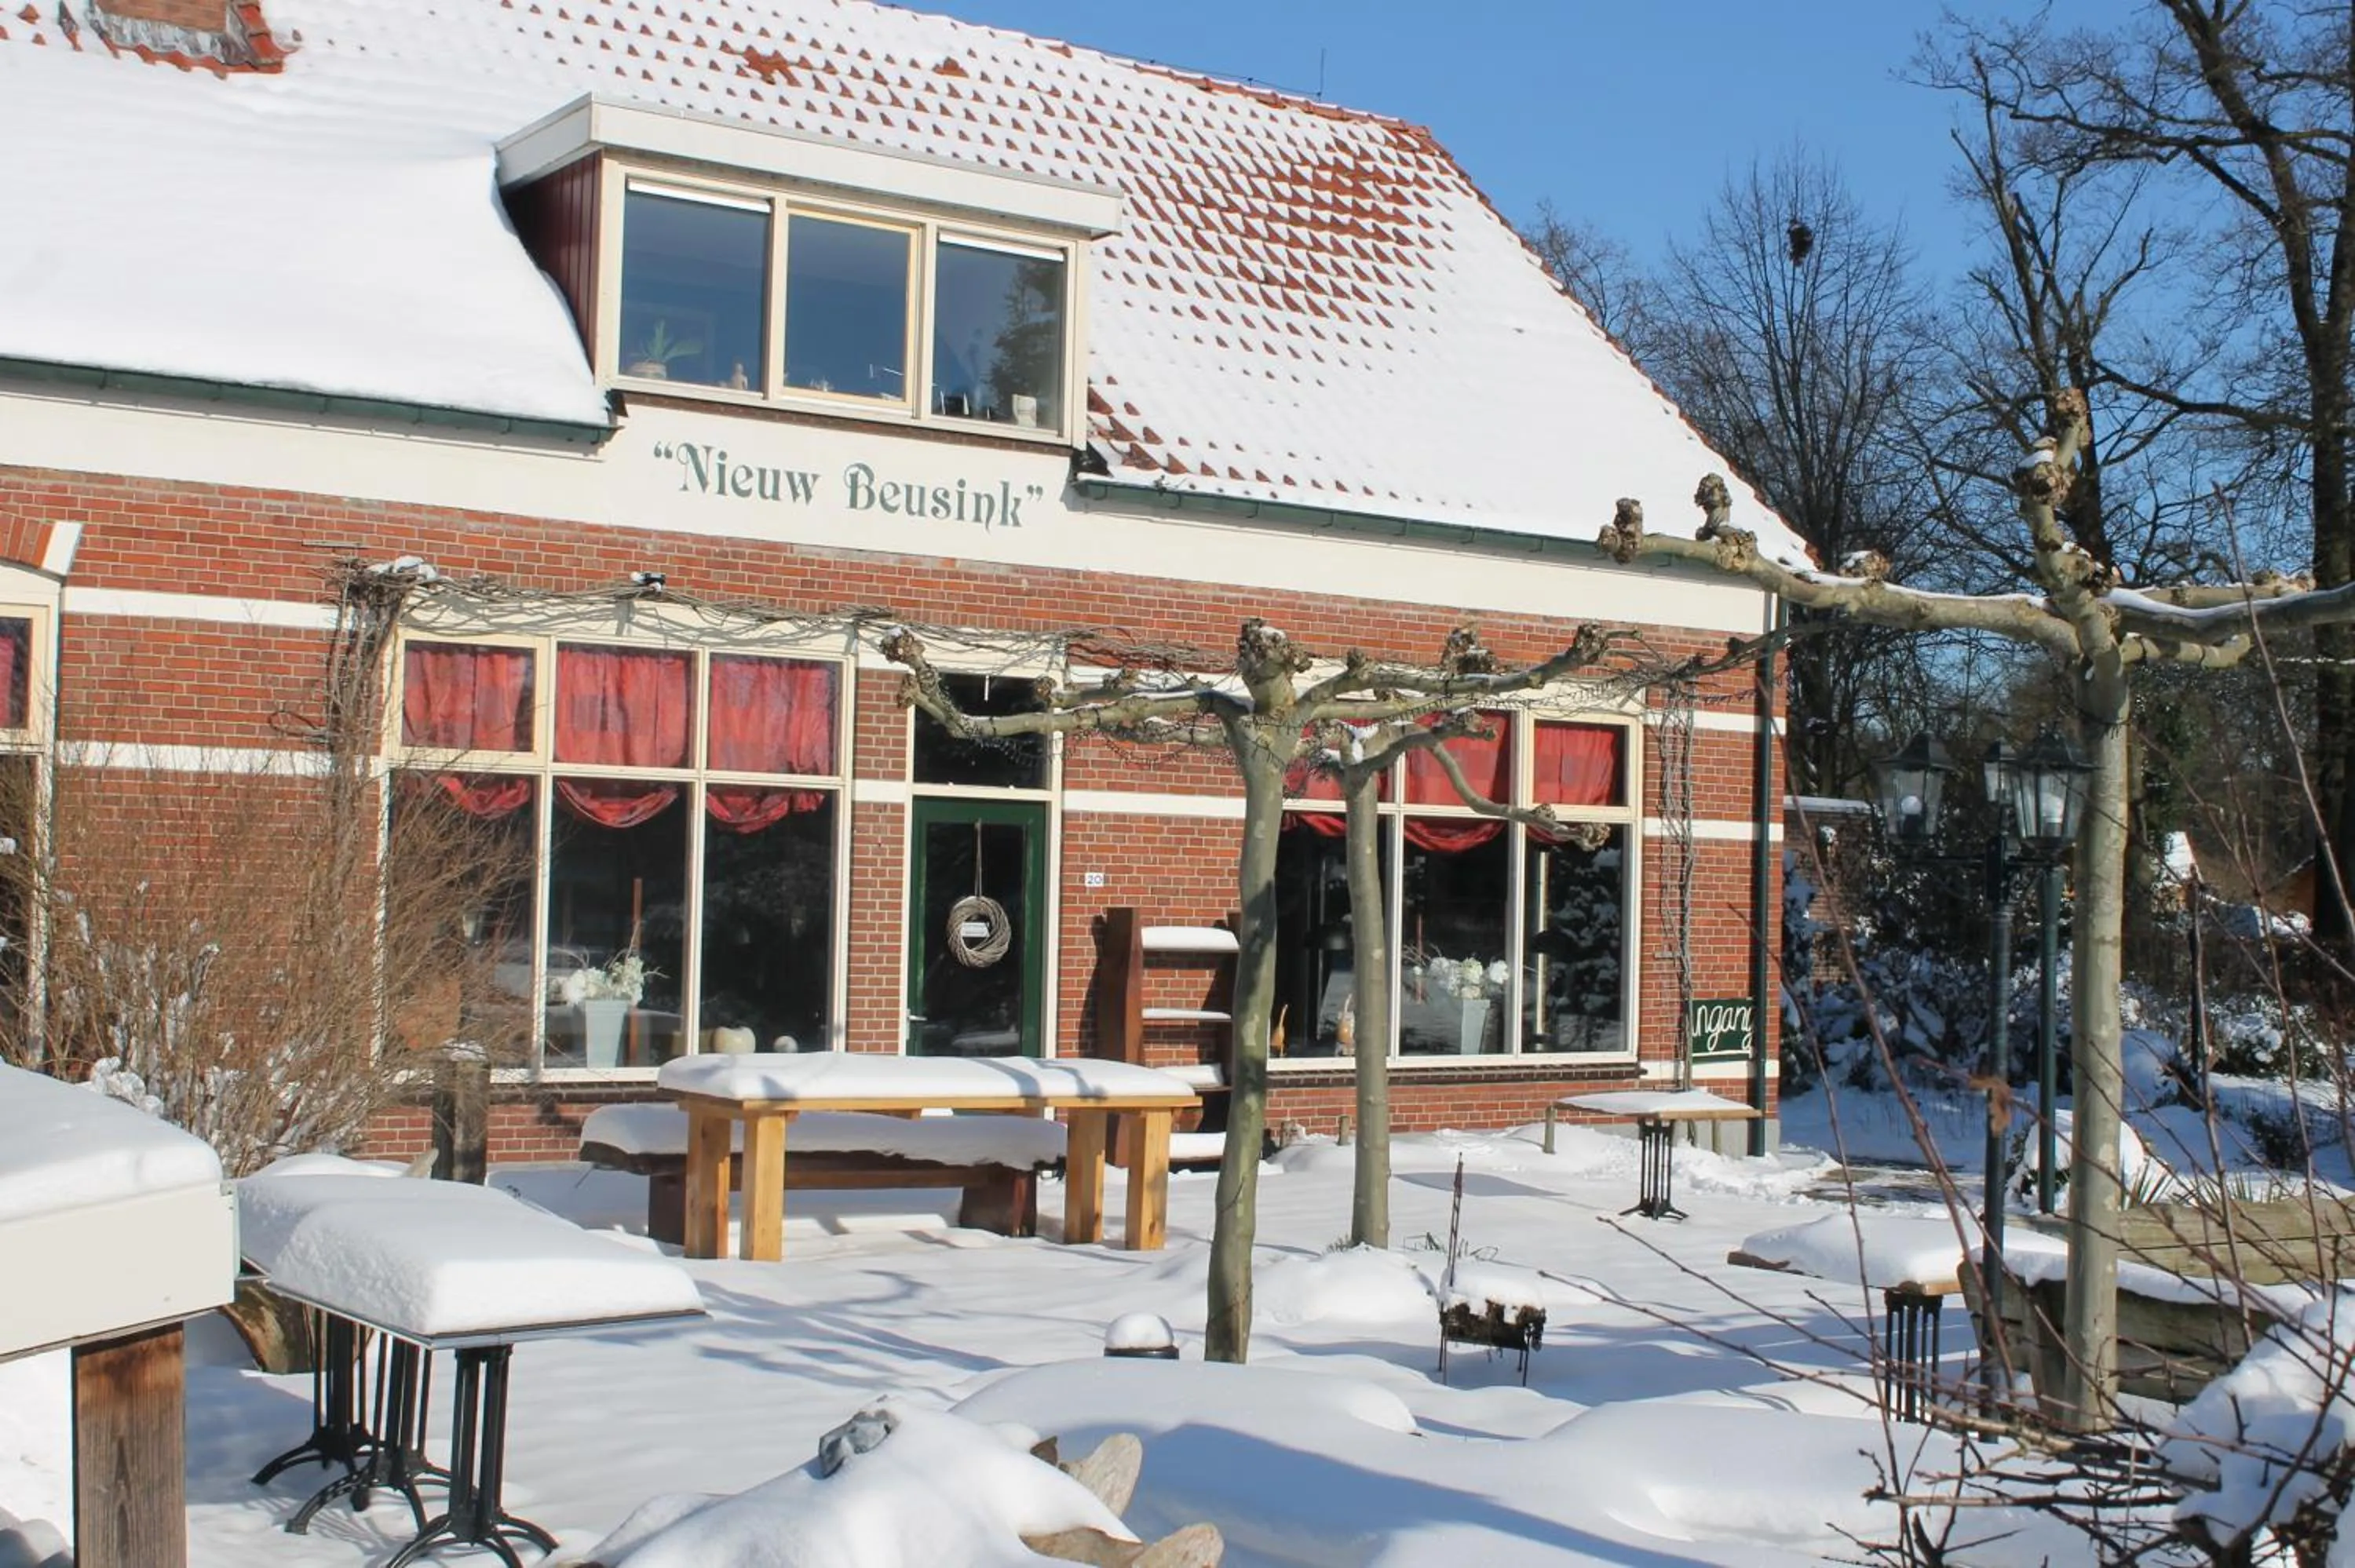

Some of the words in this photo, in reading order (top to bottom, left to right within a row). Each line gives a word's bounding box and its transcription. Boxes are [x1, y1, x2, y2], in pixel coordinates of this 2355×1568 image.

[653, 442, 820, 506] “Nieuw
[843, 462, 1044, 535] Beusink”
[1087, 875, 1103, 885] 20
[1692, 1005, 1753, 1052] ngang
